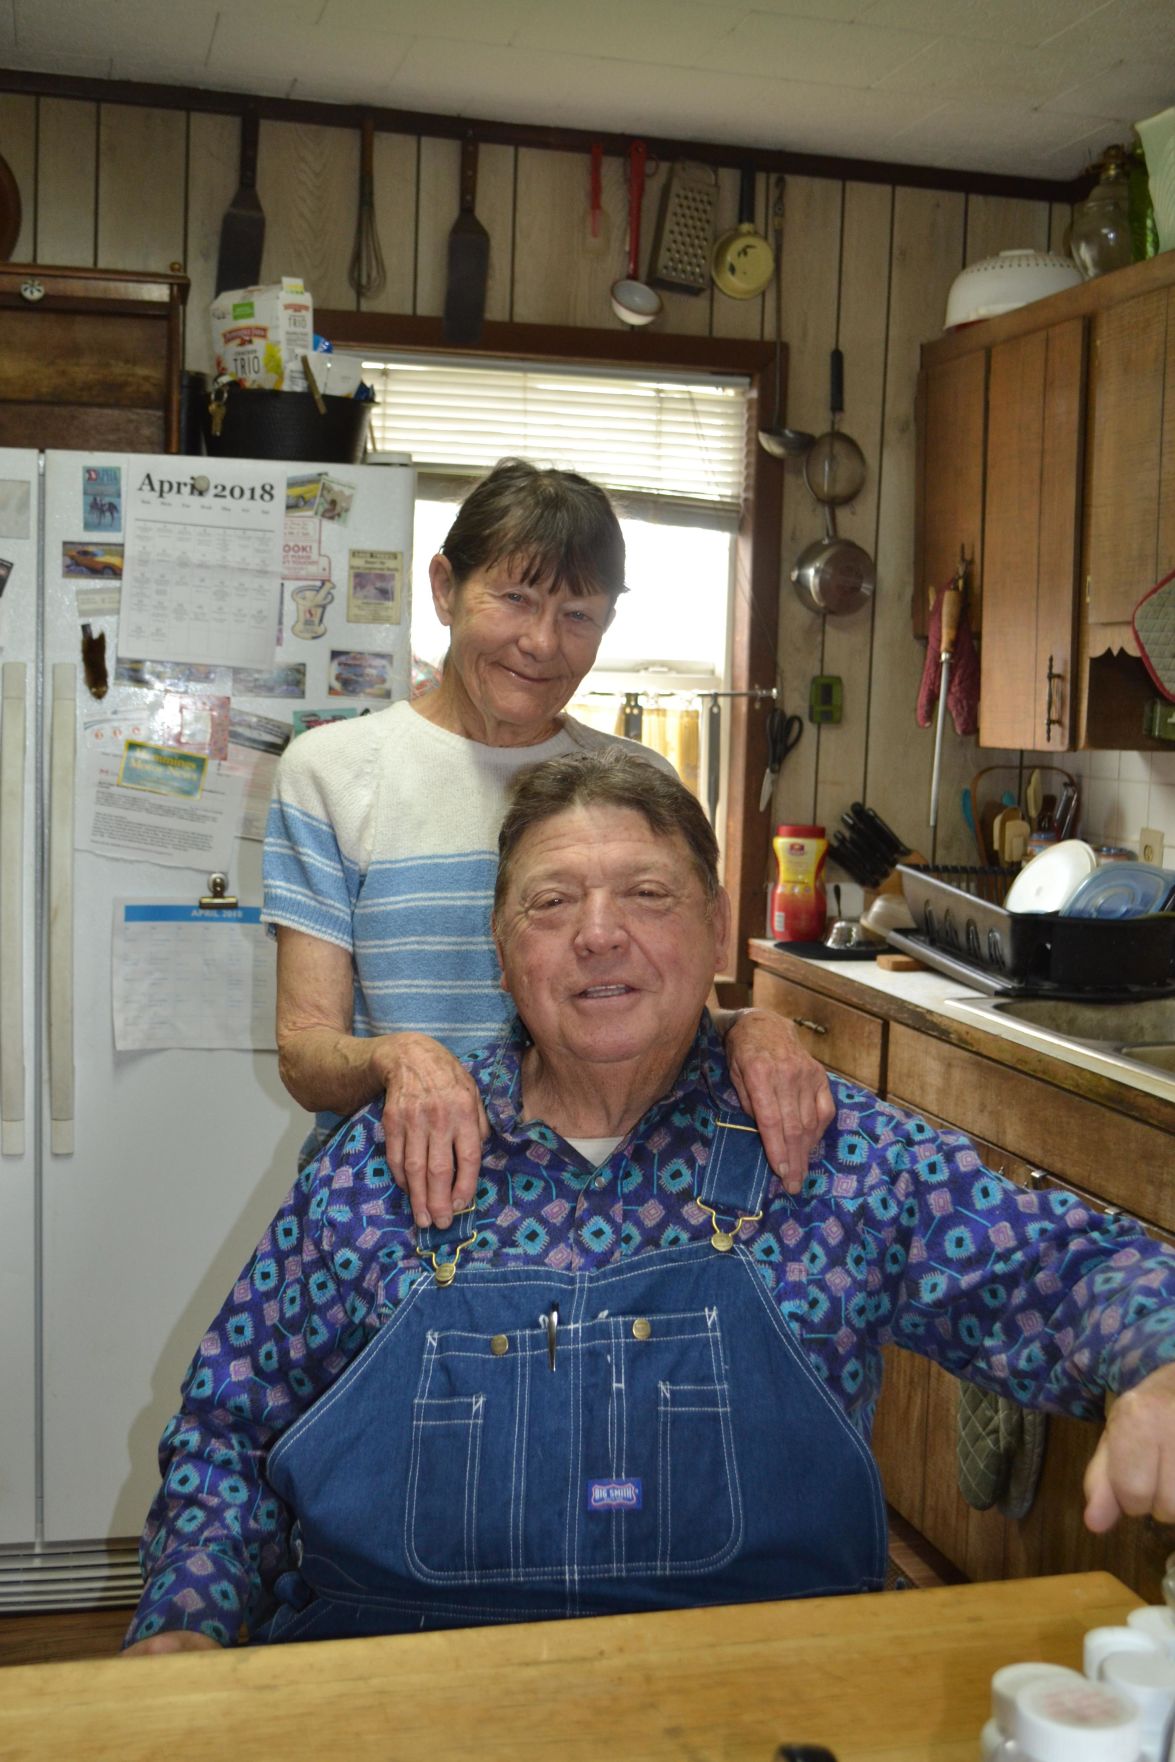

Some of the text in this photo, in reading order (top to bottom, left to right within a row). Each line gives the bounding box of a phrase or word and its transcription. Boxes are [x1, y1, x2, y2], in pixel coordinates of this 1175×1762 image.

[233, 356, 260, 377] TRIO
[213, 483, 275, 503] 2018
[282, 543, 312, 553] OOK!
